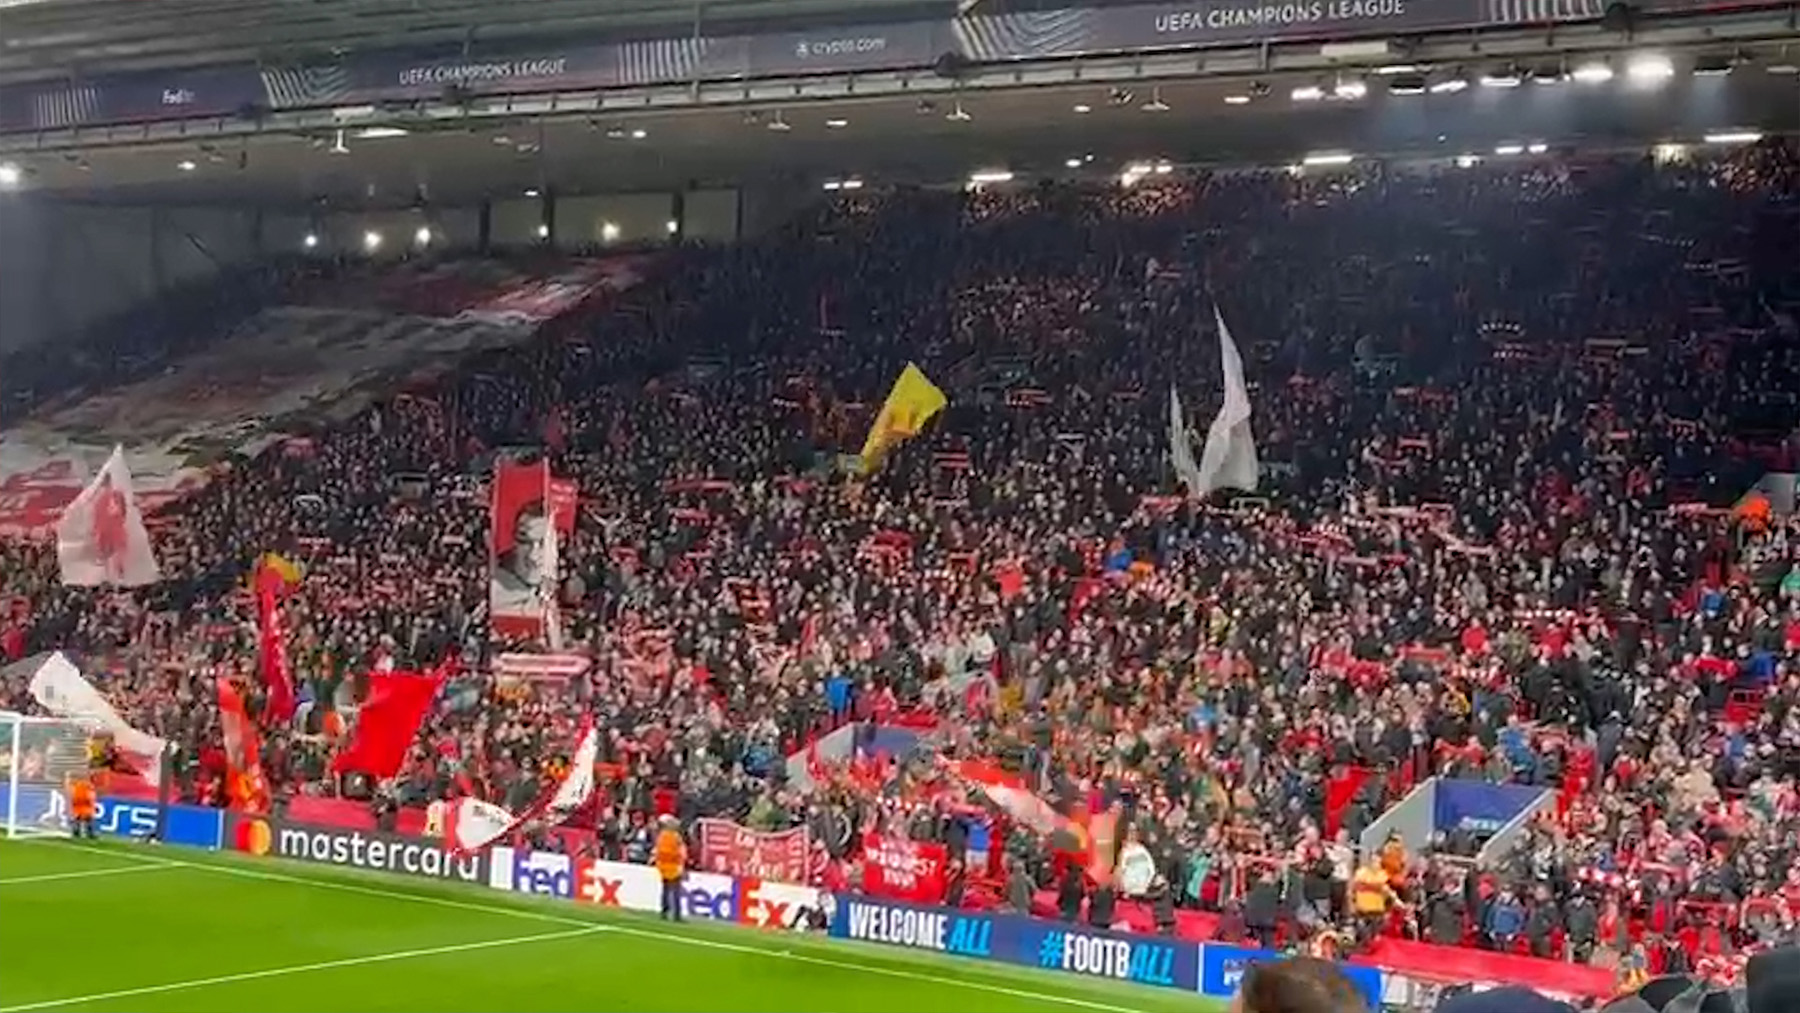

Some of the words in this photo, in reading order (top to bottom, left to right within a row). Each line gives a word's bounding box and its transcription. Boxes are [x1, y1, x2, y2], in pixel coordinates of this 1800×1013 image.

[1155, 13, 1203, 32] UEFA
[1207, 2, 1322, 28] CHAMPIONS
[1328, 0, 1405, 19] LEAGUE
[400, 68, 432, 85] UEFA
[434, 61, 510, 82] CHAMPIONS
[514, 57, 566, 76] LEAGUE
[510, 848, 623, 906] FedEx
[849, 902, 948, 949] WELCOME
[949, 917, 992, 956] ALL
[1037, 929, 1174, 985] #FOOTBALL
